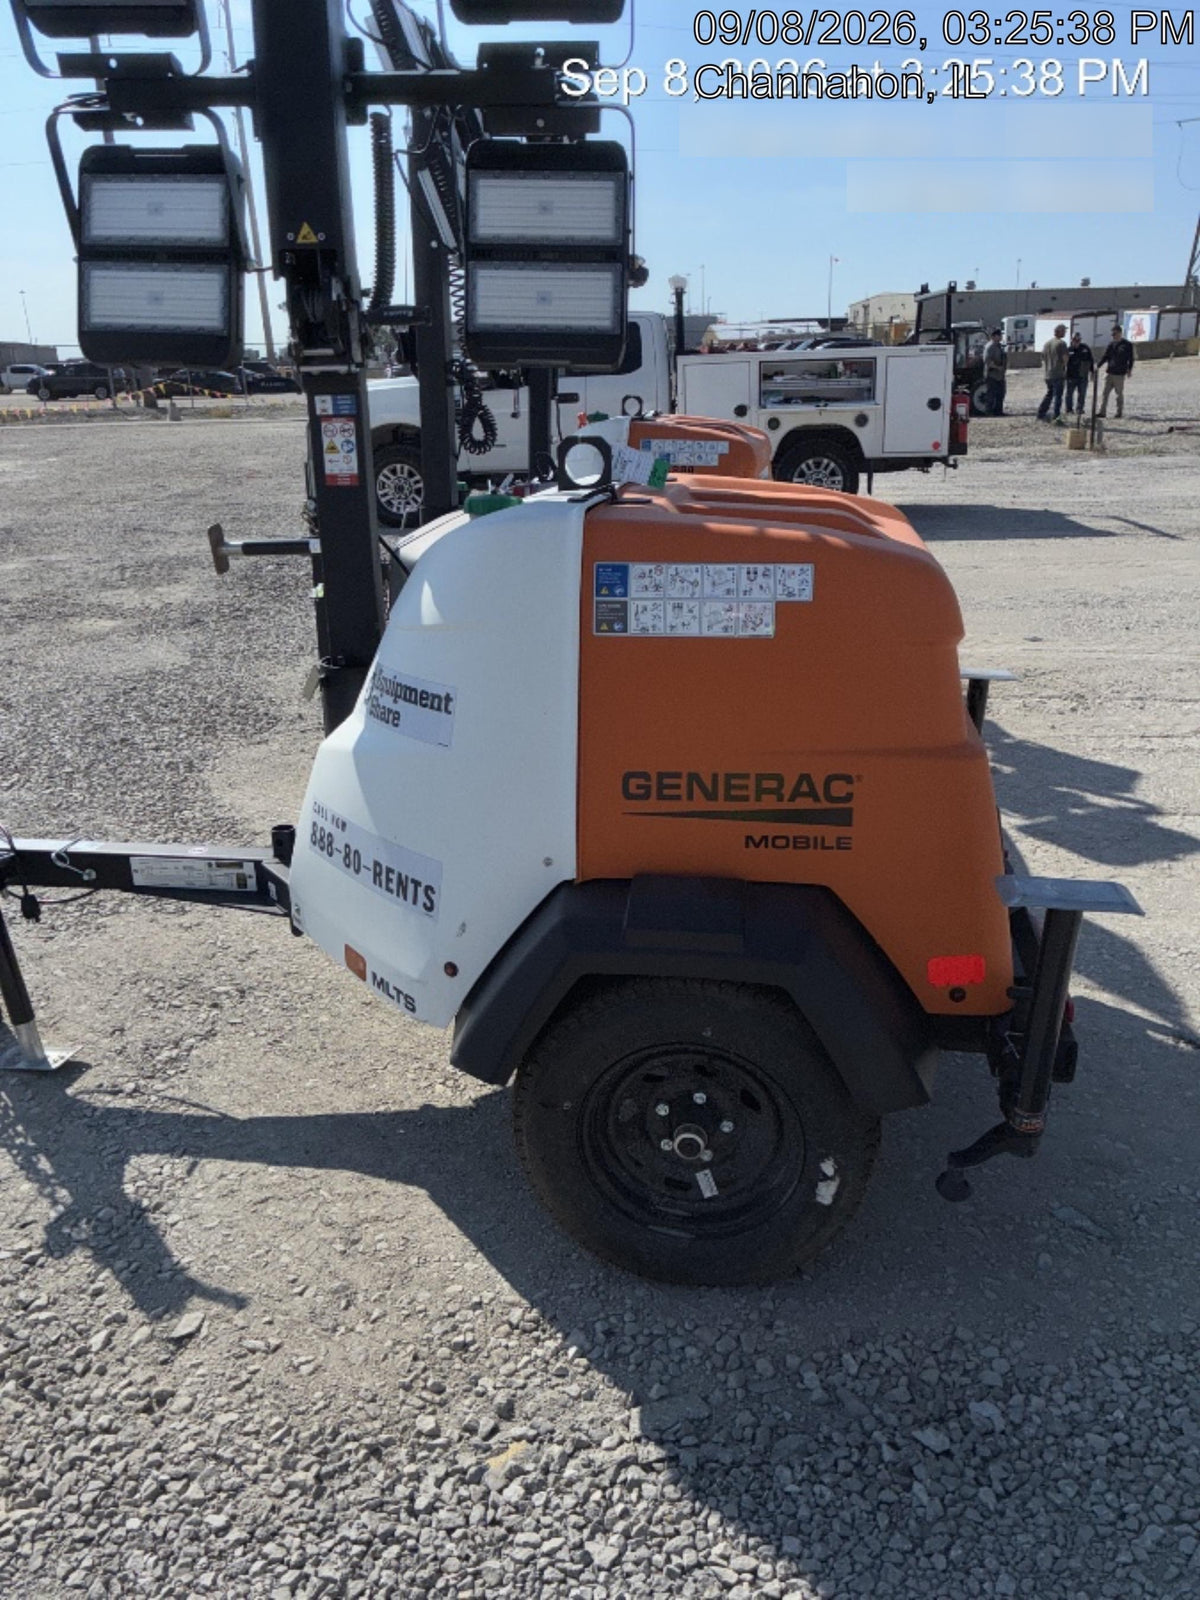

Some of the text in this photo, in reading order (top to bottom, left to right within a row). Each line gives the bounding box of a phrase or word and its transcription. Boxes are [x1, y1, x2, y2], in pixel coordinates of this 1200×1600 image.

[621, 771, 854, 804] GENERAC
[744, 835, 853, 850] MOBILE
[310, 821, 436, 913] 888-80-RENTS
[371, 970, 416, 1014] MLTS
